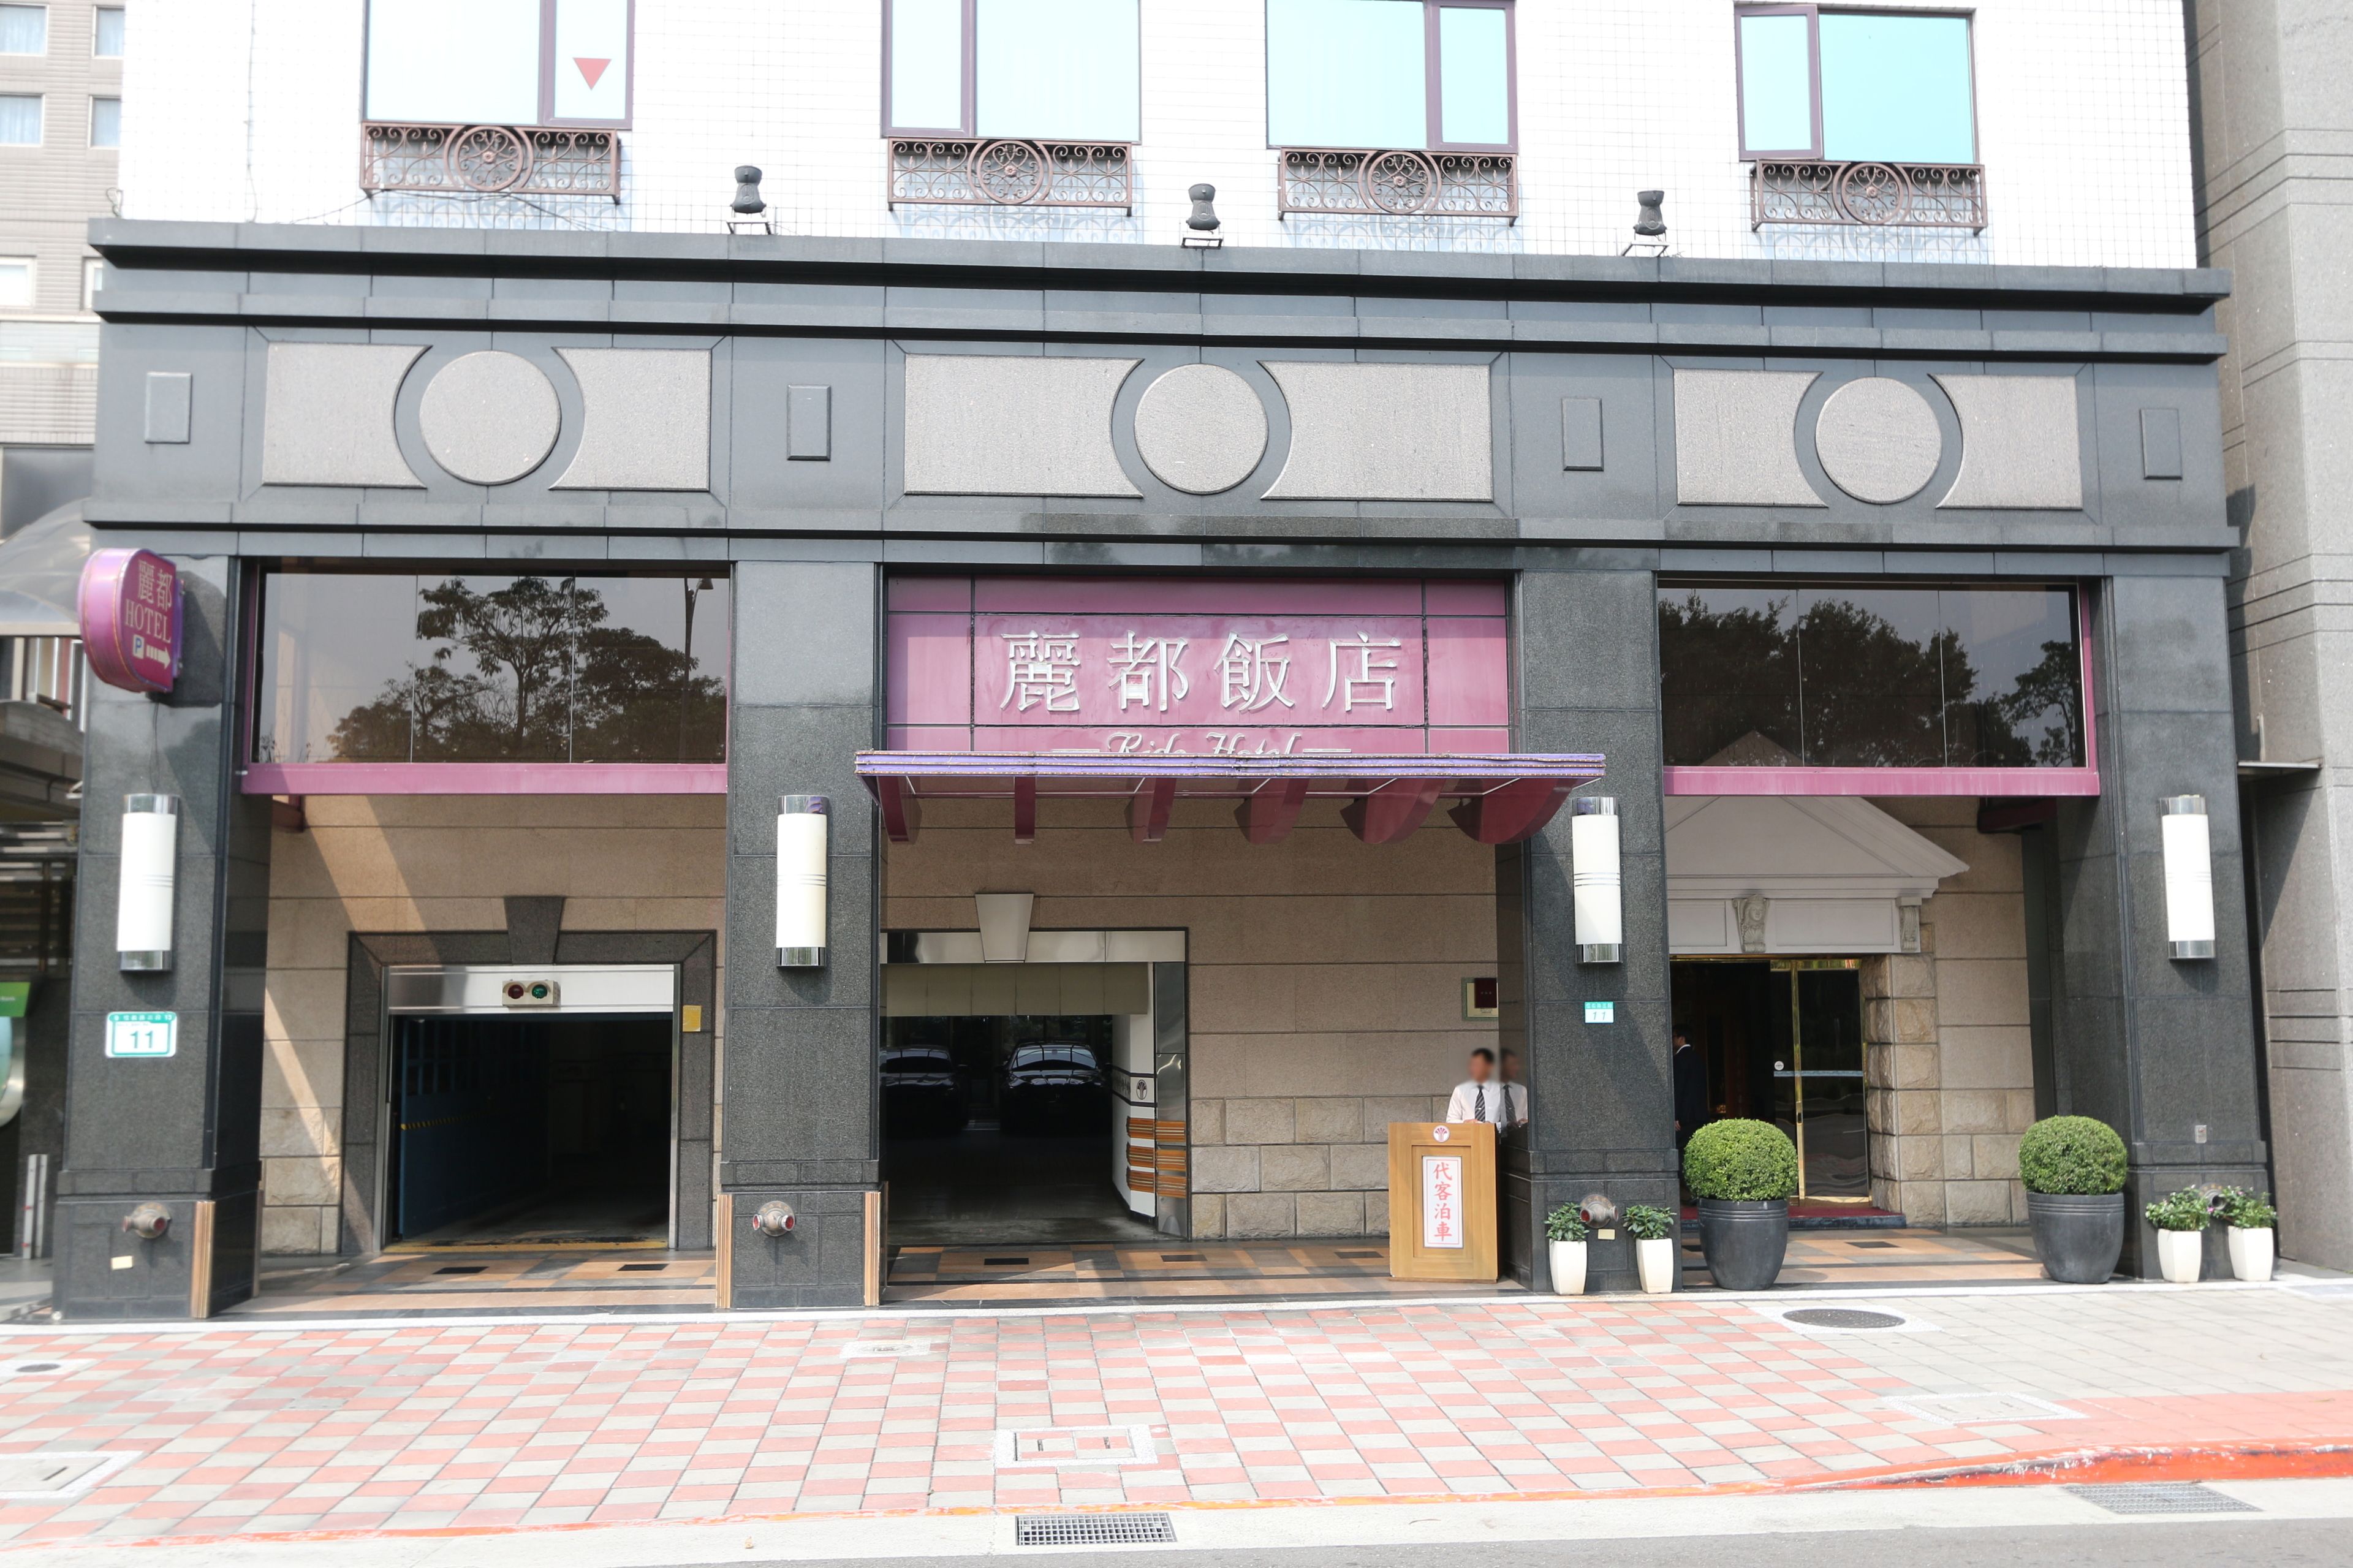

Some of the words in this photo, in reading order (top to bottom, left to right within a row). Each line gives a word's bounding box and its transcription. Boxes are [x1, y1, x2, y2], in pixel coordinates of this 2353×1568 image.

[138, 559, 172, 611] 麗都
[125, 599, 171, 643] HOTEL
[1000, 631, 1401, 712] 麗都飯店
[1107, 732, 1186, 754] Rid
[1207, 733, 1302, 754] Htl
[1593, 1011, 1606, 1020] 11
[130, 1031, 154, 1048] 11
[1433, 1162, 1452, 1241] 代客泊車
